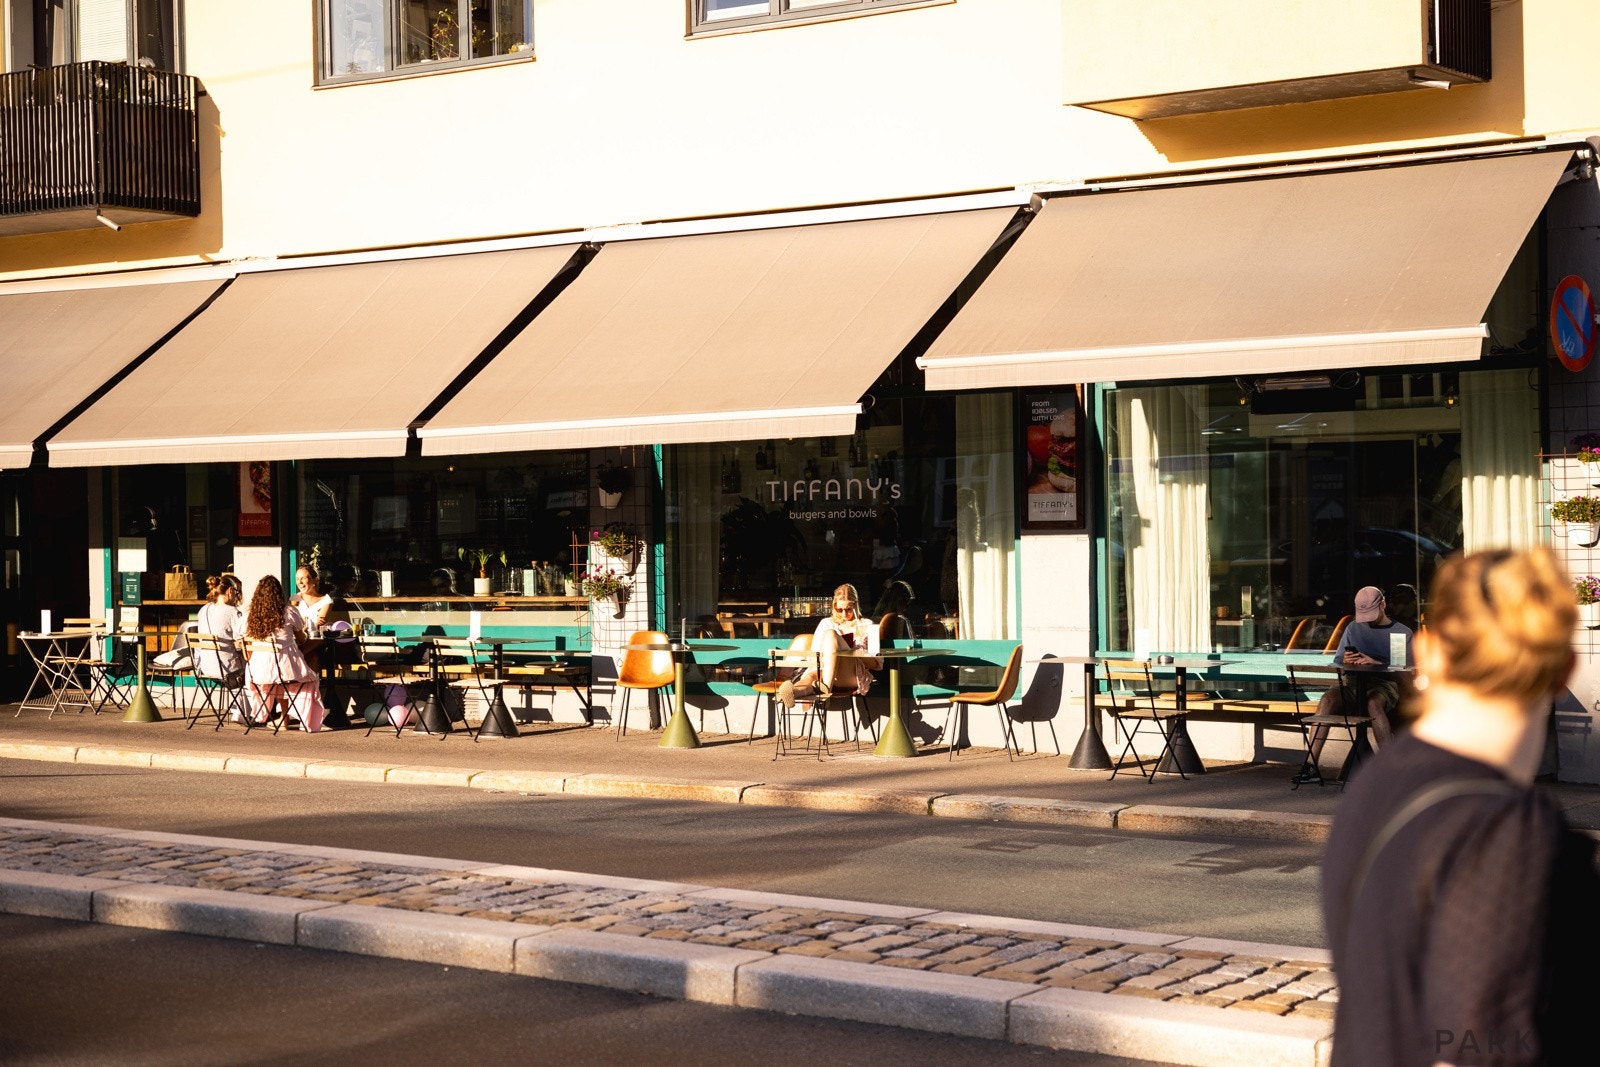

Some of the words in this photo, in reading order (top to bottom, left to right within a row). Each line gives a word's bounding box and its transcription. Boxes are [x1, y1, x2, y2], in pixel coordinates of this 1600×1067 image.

[766, 477, 901, 501] TIFFANY's
[789, 509, 826, 521] burgers
[827, 509, 846, 519] and
[849, 508, 877, 518] bowls
